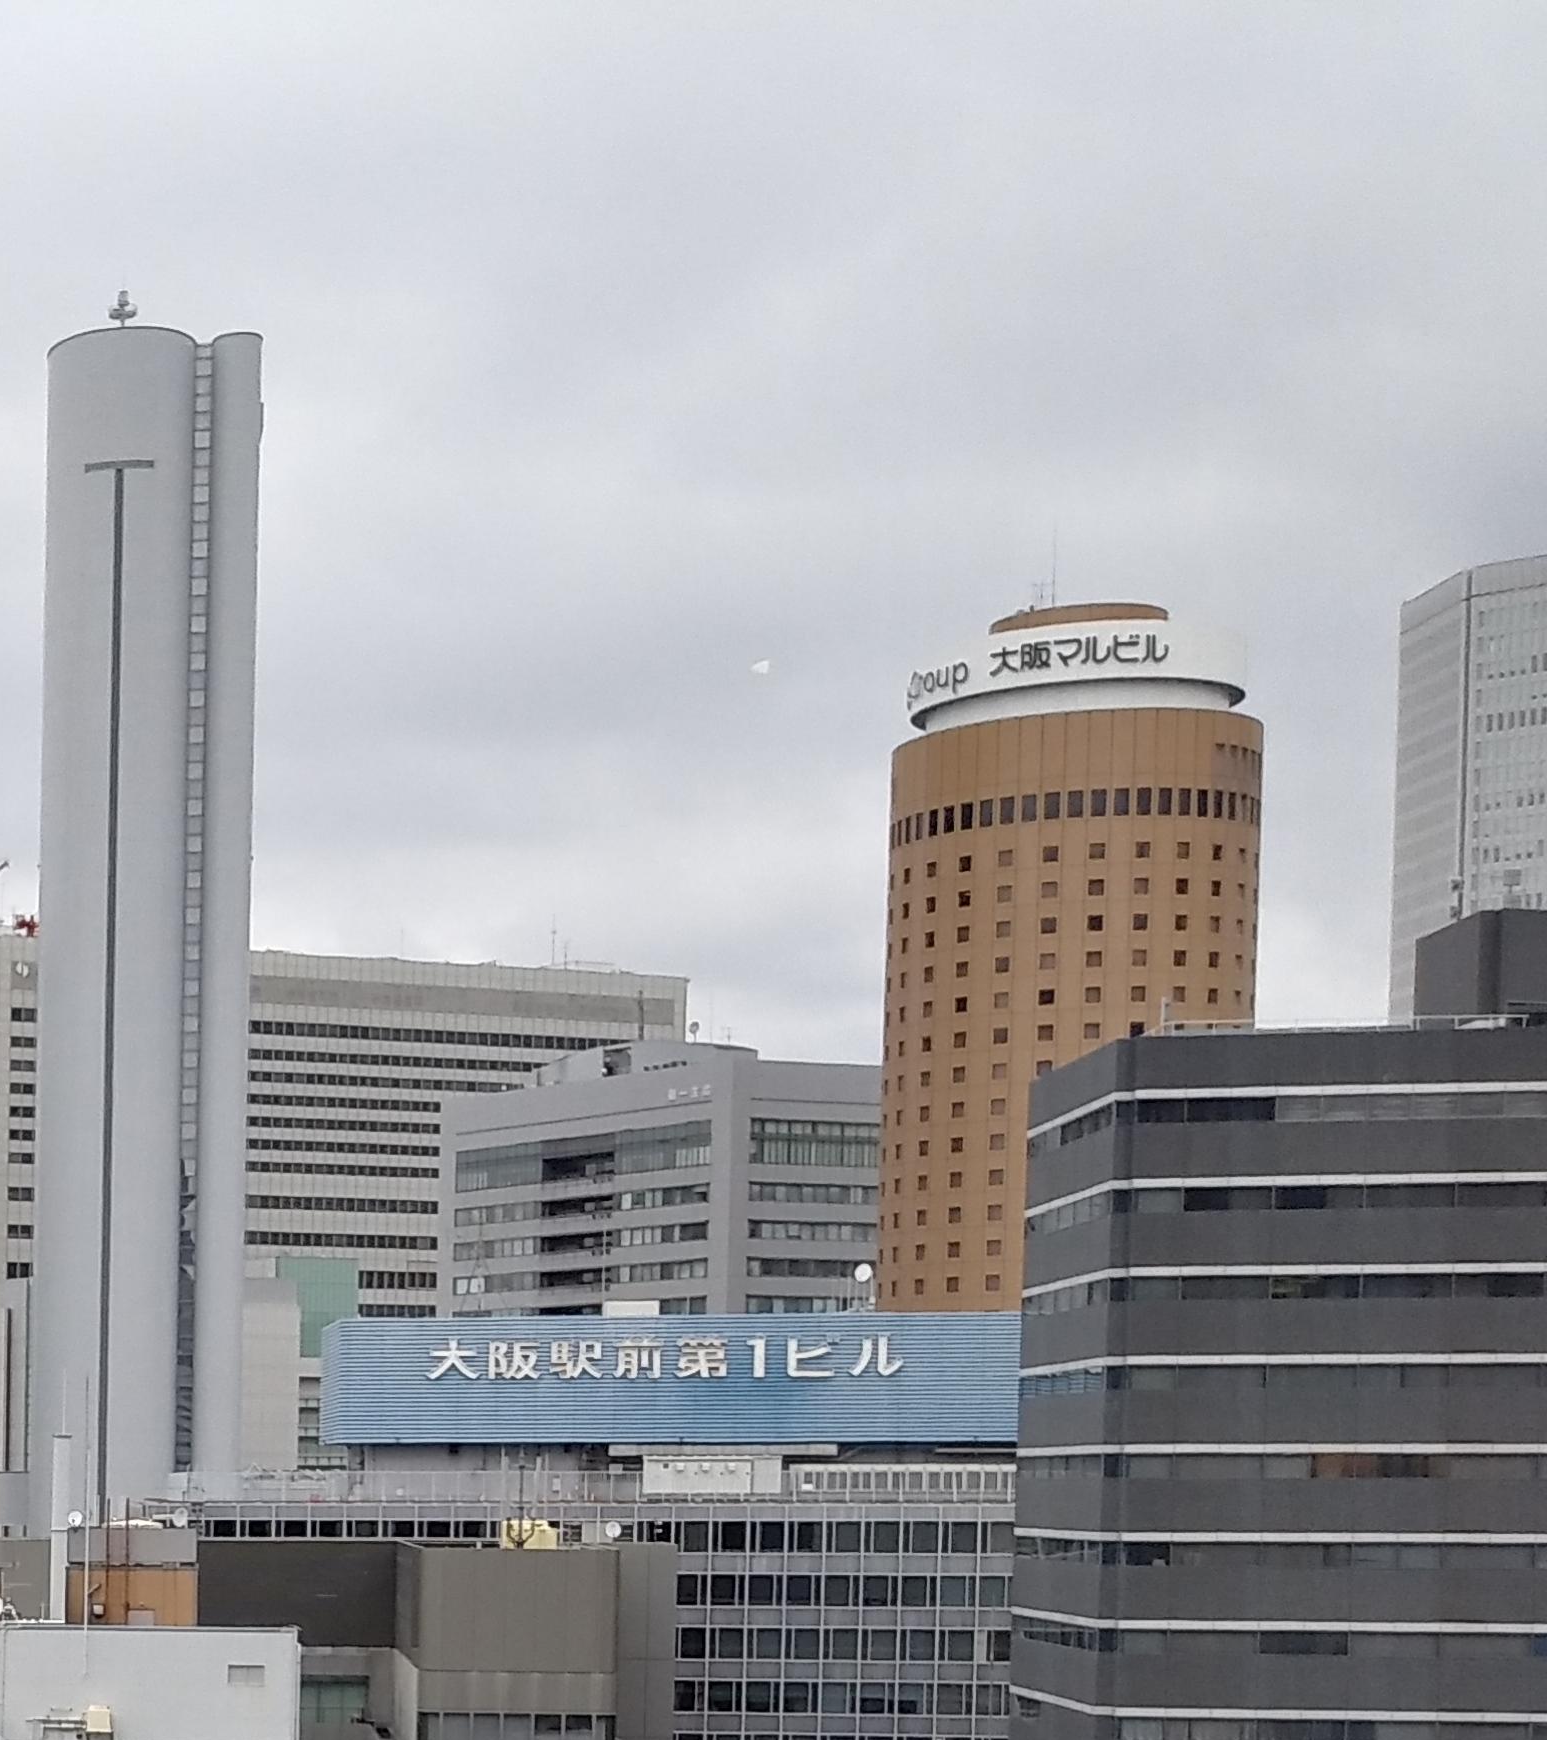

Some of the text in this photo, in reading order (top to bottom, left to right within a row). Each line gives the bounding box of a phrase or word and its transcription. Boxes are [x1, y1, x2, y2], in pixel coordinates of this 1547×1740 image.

[988, 633, 1171, 679] 大阪マルビル
[425, 1333, 905, 1381] 大阪駅前第1ビル
